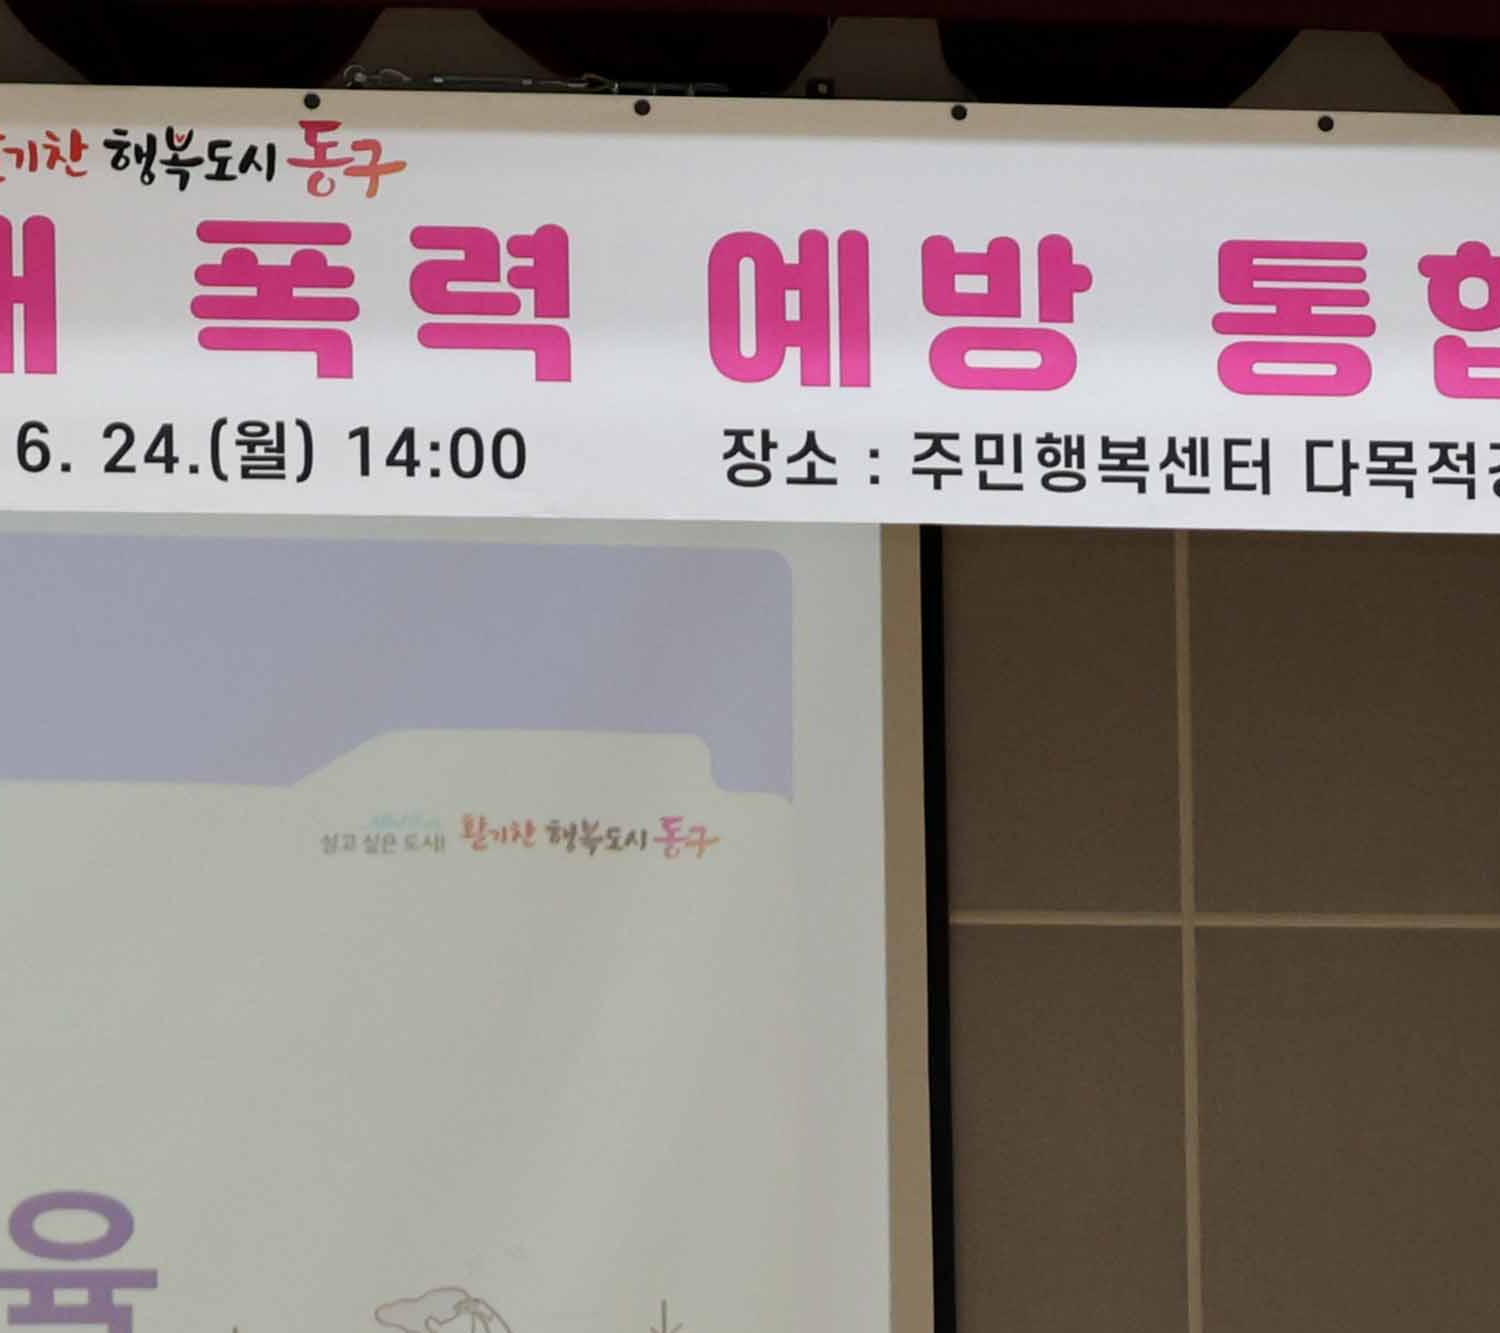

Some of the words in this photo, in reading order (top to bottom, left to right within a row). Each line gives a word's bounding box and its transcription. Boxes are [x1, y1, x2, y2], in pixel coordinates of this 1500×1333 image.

[103, 126, 276, 192] 행복도시
[285, 119, 407, 198] 동구
[190, 220, 572, 382] 폭력
[707, 229, 1093, 391] 예방
[17, 421, 71, 473] 6.
[103, 417, 313, 483] 24.(월)
[348, 426, 526, 479] 14:00
[723, 429, 837, 487] 장소
[912, 432, 1270, 495] 주민행복센터
[543, 818, 649, 856] 행복도시
[653, 815, 727, 859] 동구
